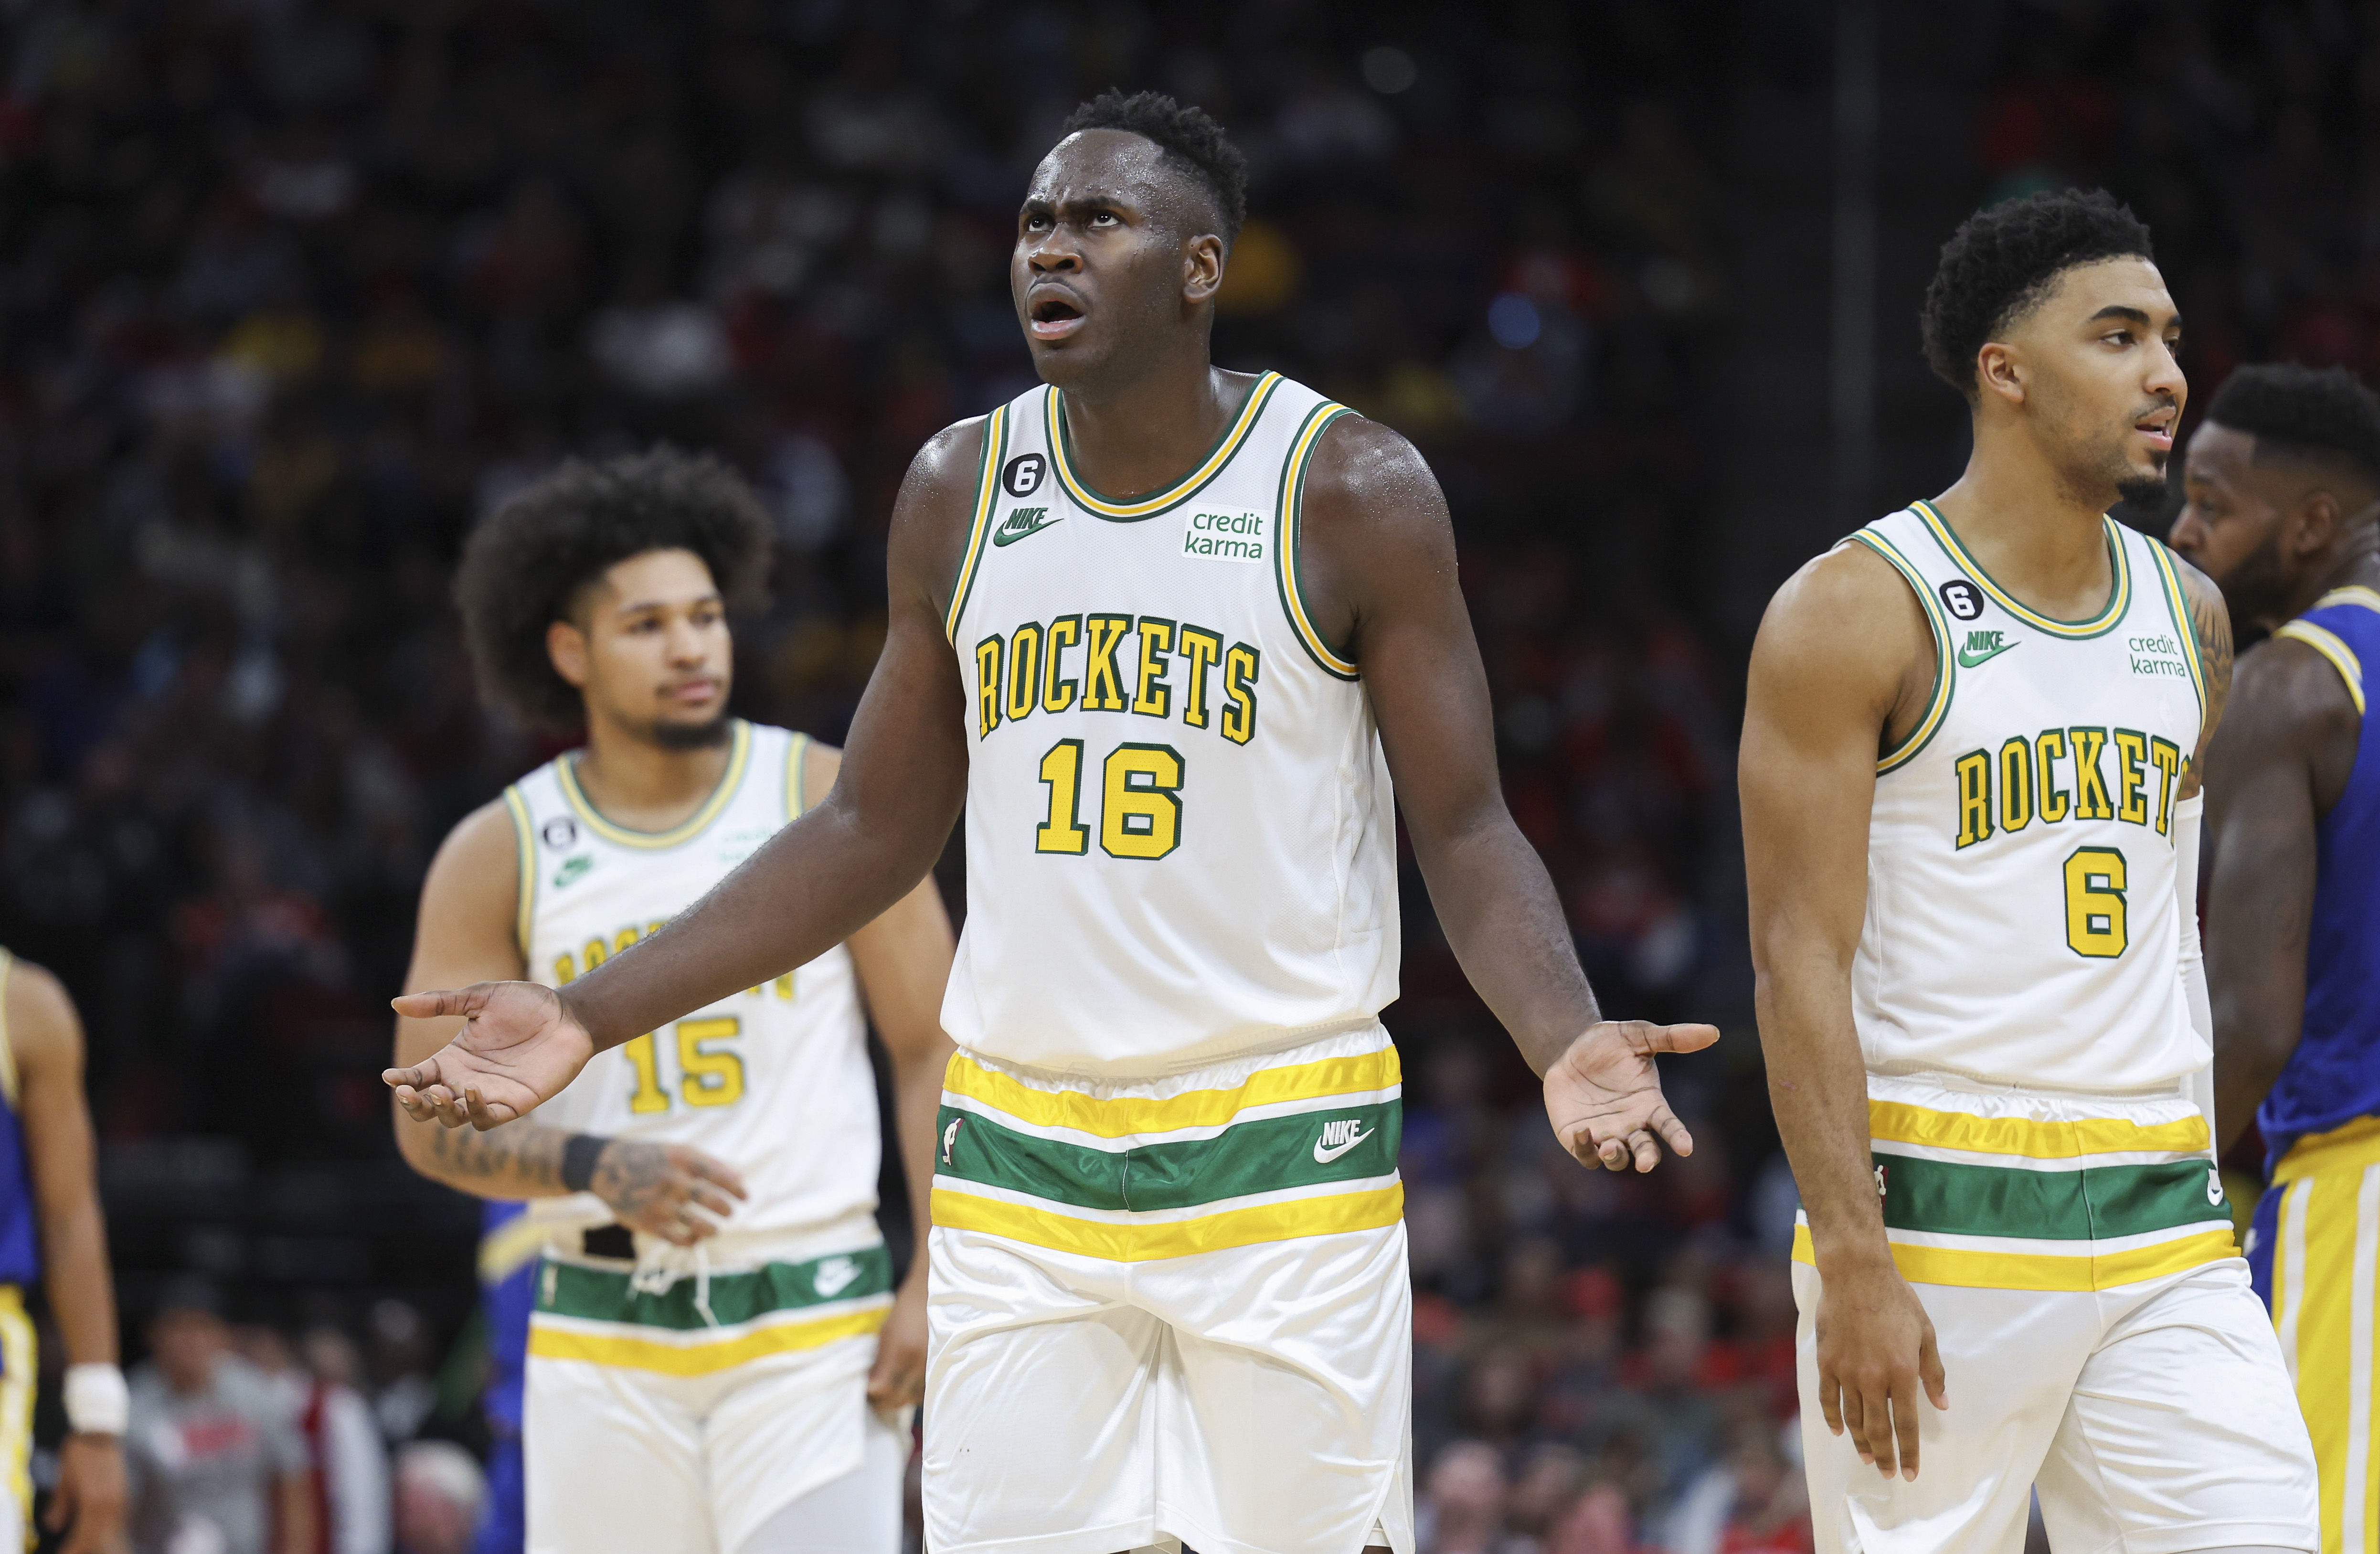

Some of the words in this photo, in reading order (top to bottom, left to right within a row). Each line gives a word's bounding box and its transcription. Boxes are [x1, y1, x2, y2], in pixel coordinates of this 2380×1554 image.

[1013, 459, 1039, 492] 6
[1004, 507, 1049, 529] NIKE
[1193, 512, 1263, 535] credit
[1184, 531, 1263, 559] karma
[1945, 585, 1976, 617] 6
[1966, 631, 2004, 651] NIKE
[2129, 634, 2178, 655] credit
[2130, 653, 2186, 677] karma
[976, 613, 1260, 746] ROCKETS
[1035, 738, 1185, 861] 16
[2063, 846, 2128, 958] 6
[624, 1016, 745, 1114] 15
[1322, 1119, 1361, 1146] NIKE
